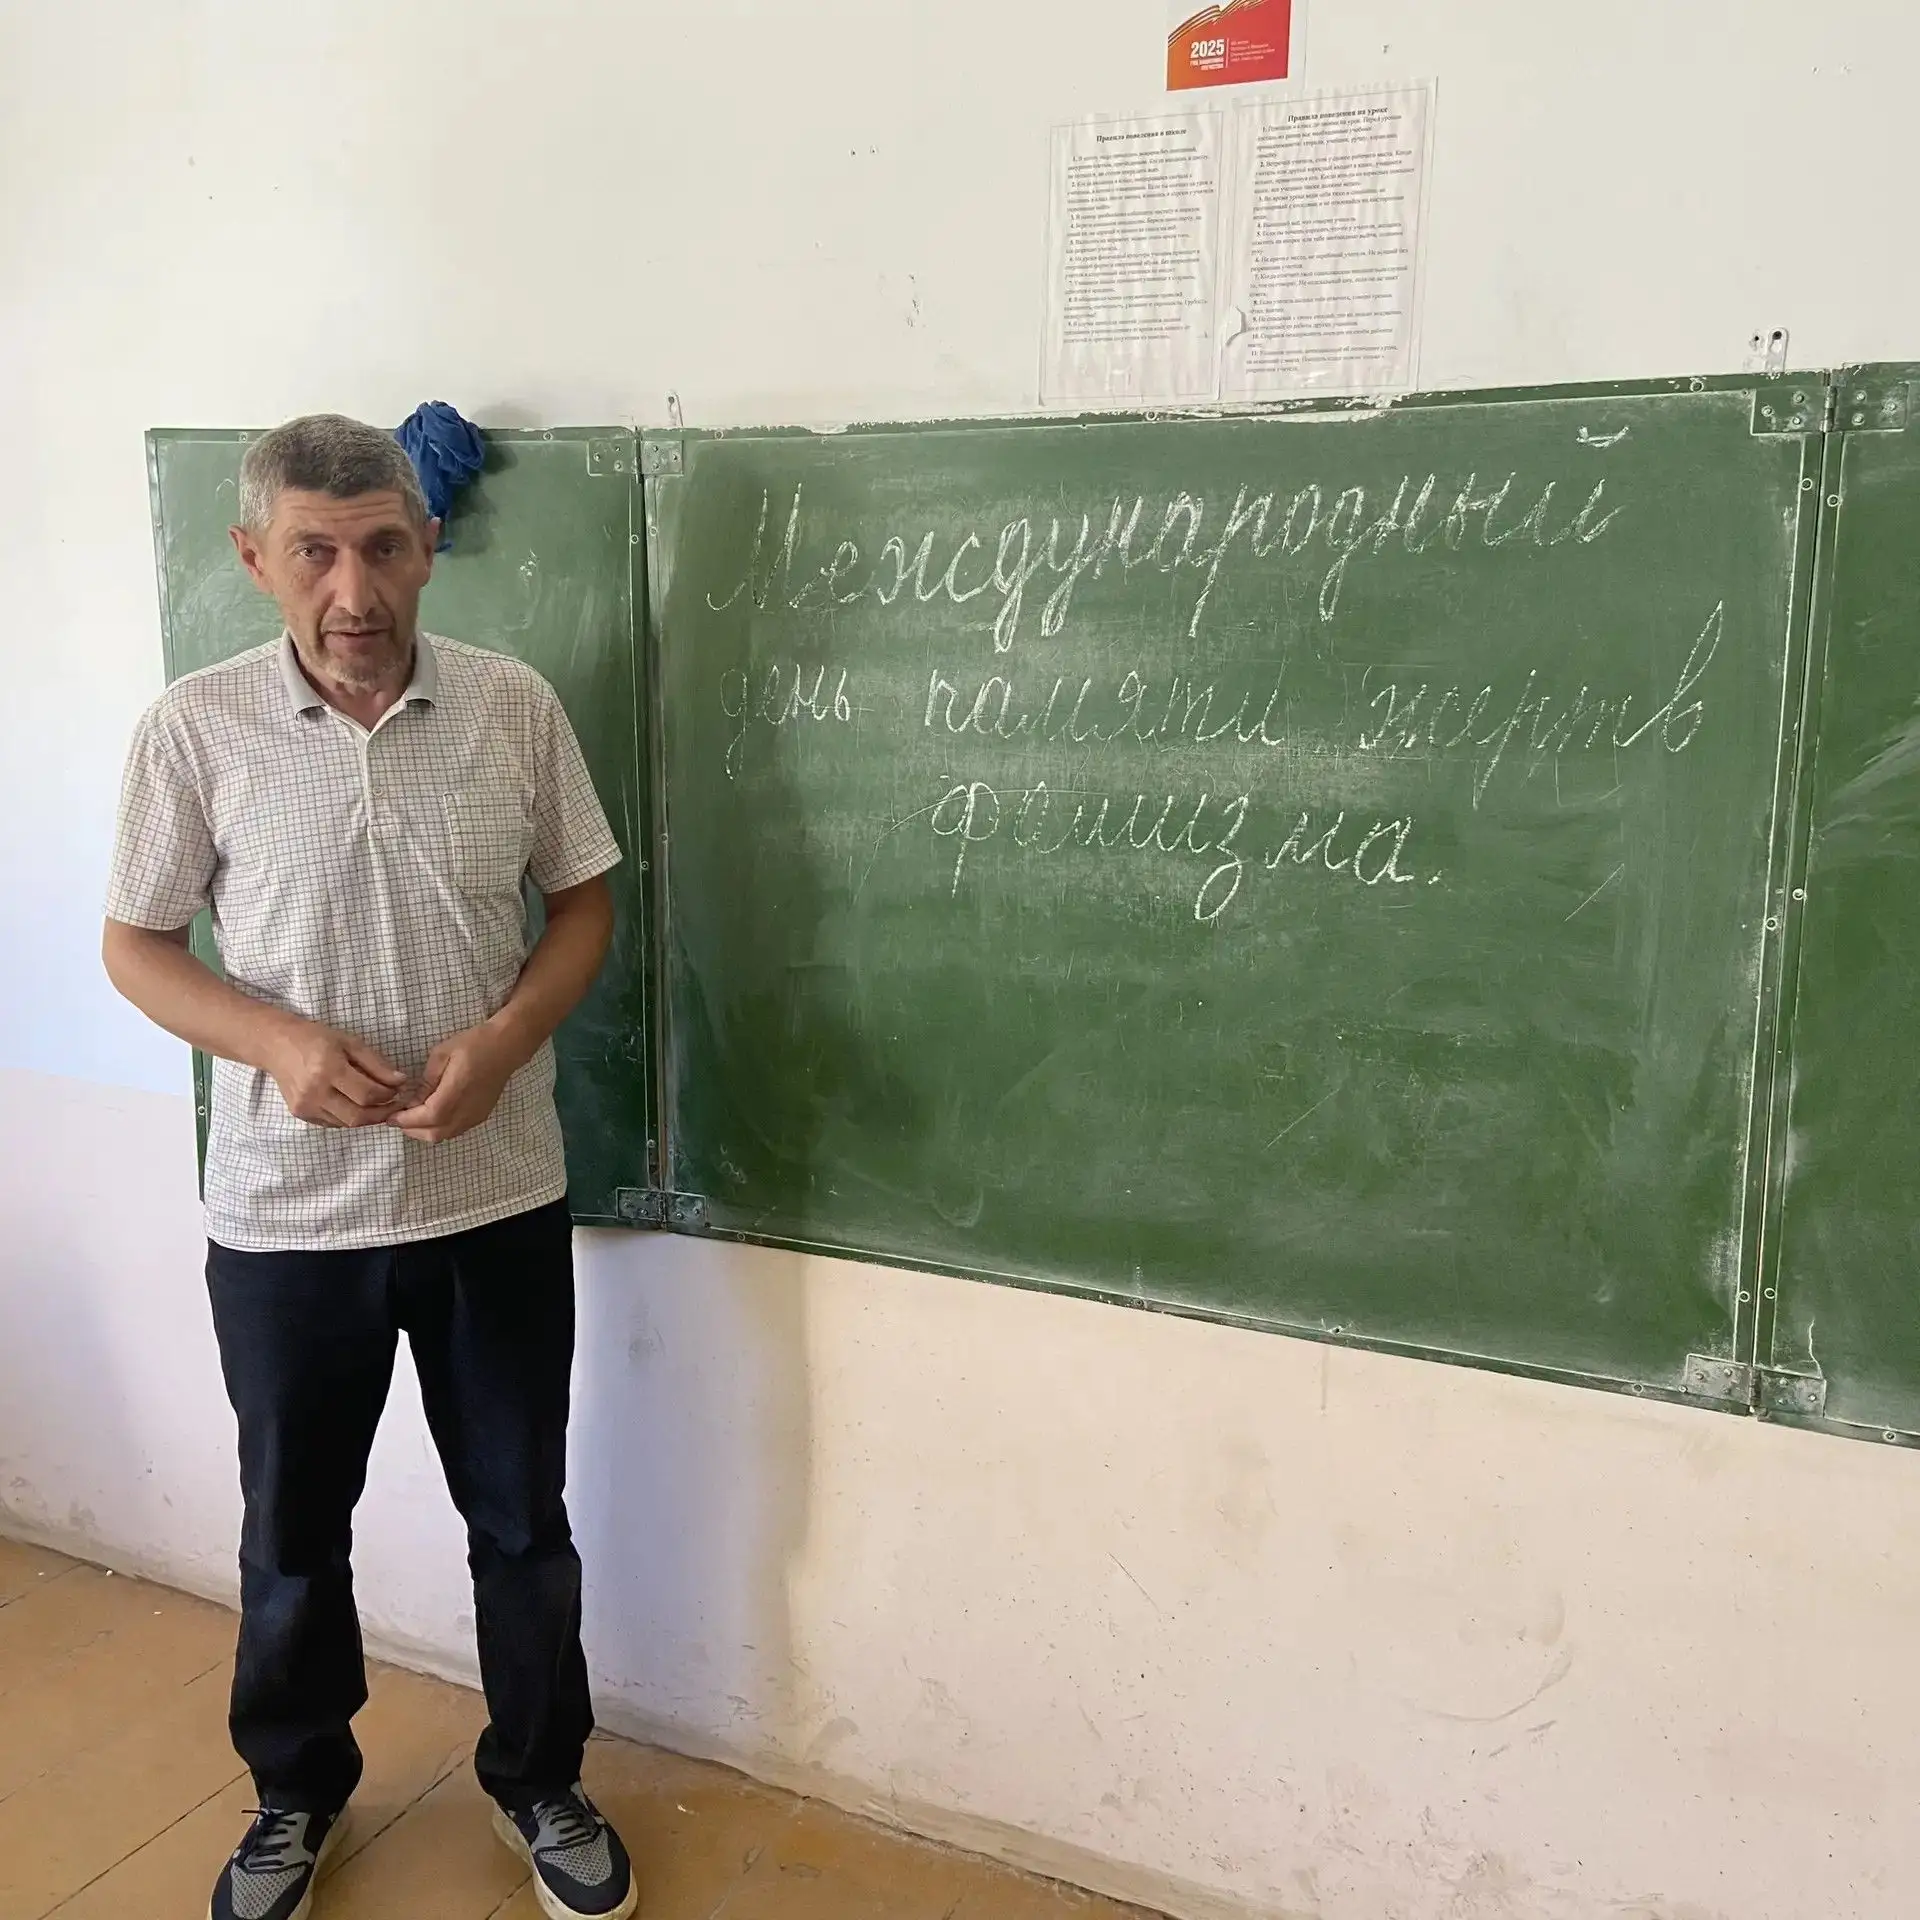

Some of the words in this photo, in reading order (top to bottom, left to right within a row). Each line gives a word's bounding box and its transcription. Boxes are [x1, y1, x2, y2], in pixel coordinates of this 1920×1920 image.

[1190, 39, 1225, 58] 2025
[707, 425, 1632, 653] Международный
[720, 664, 851, 780] день
[924, 668, 1284, 748] памяти
[1360, 601, 1724, 810] жертв
